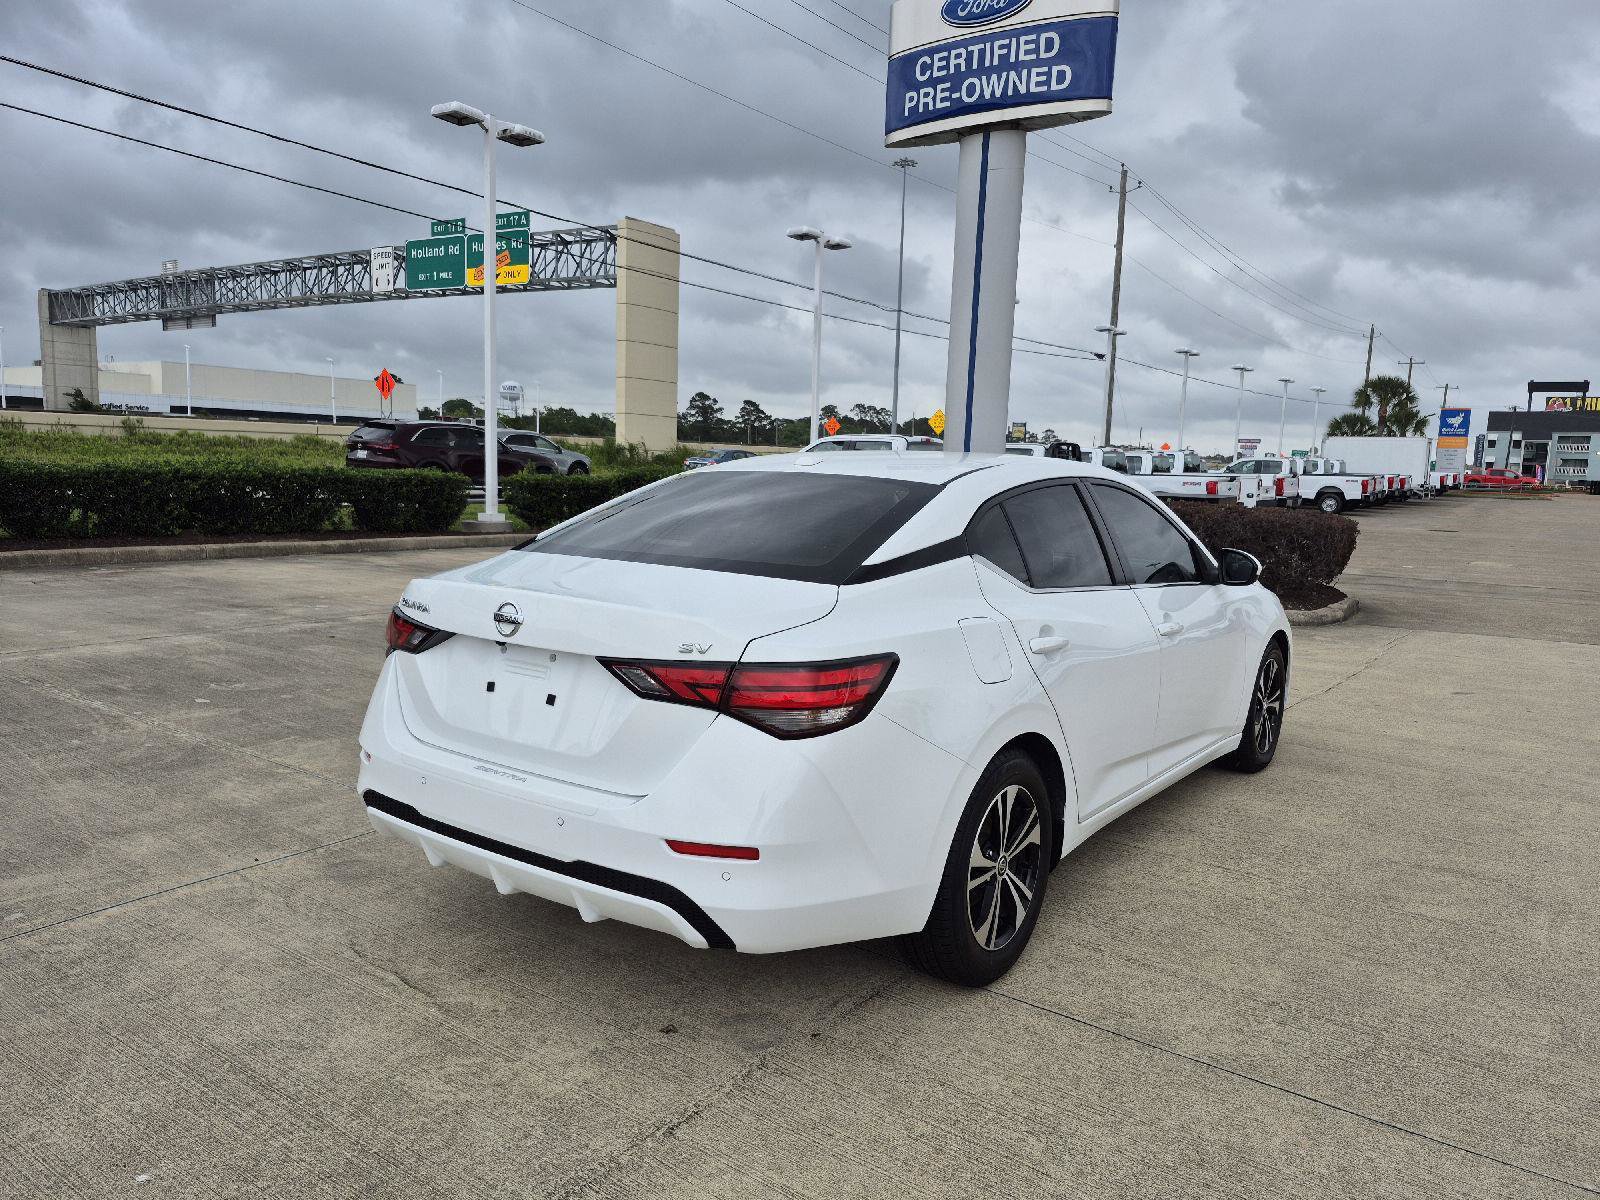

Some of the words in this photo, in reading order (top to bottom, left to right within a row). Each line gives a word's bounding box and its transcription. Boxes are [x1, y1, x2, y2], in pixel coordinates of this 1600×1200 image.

[915, 31, 1061, 82] CERTIFIED
[904, 64, 1073, 117] PRE-OWNED
[509, 215, 519, 226] 17
[520, 214, 527, 225] A
[433, 225, 445, 233] EXIT
[472, 241, 507, 253] Hues
[511, 237, 523, 249] Rd
[373, 252, 392, 260] SPEED
[411, 245, 445, 258] Holland
[448, 244, 460, 255] Rd
[376, 262, 390, 271] LIMIT
[418, 273, 430, 281] EXIT
[433, 271, 437, 280] 1
[439, 271, 453, 280] MILE
[503, 270, 522, 279] ONLY
[124, 403, 150, 411] Service
[678, 642, 713, 656] SV
